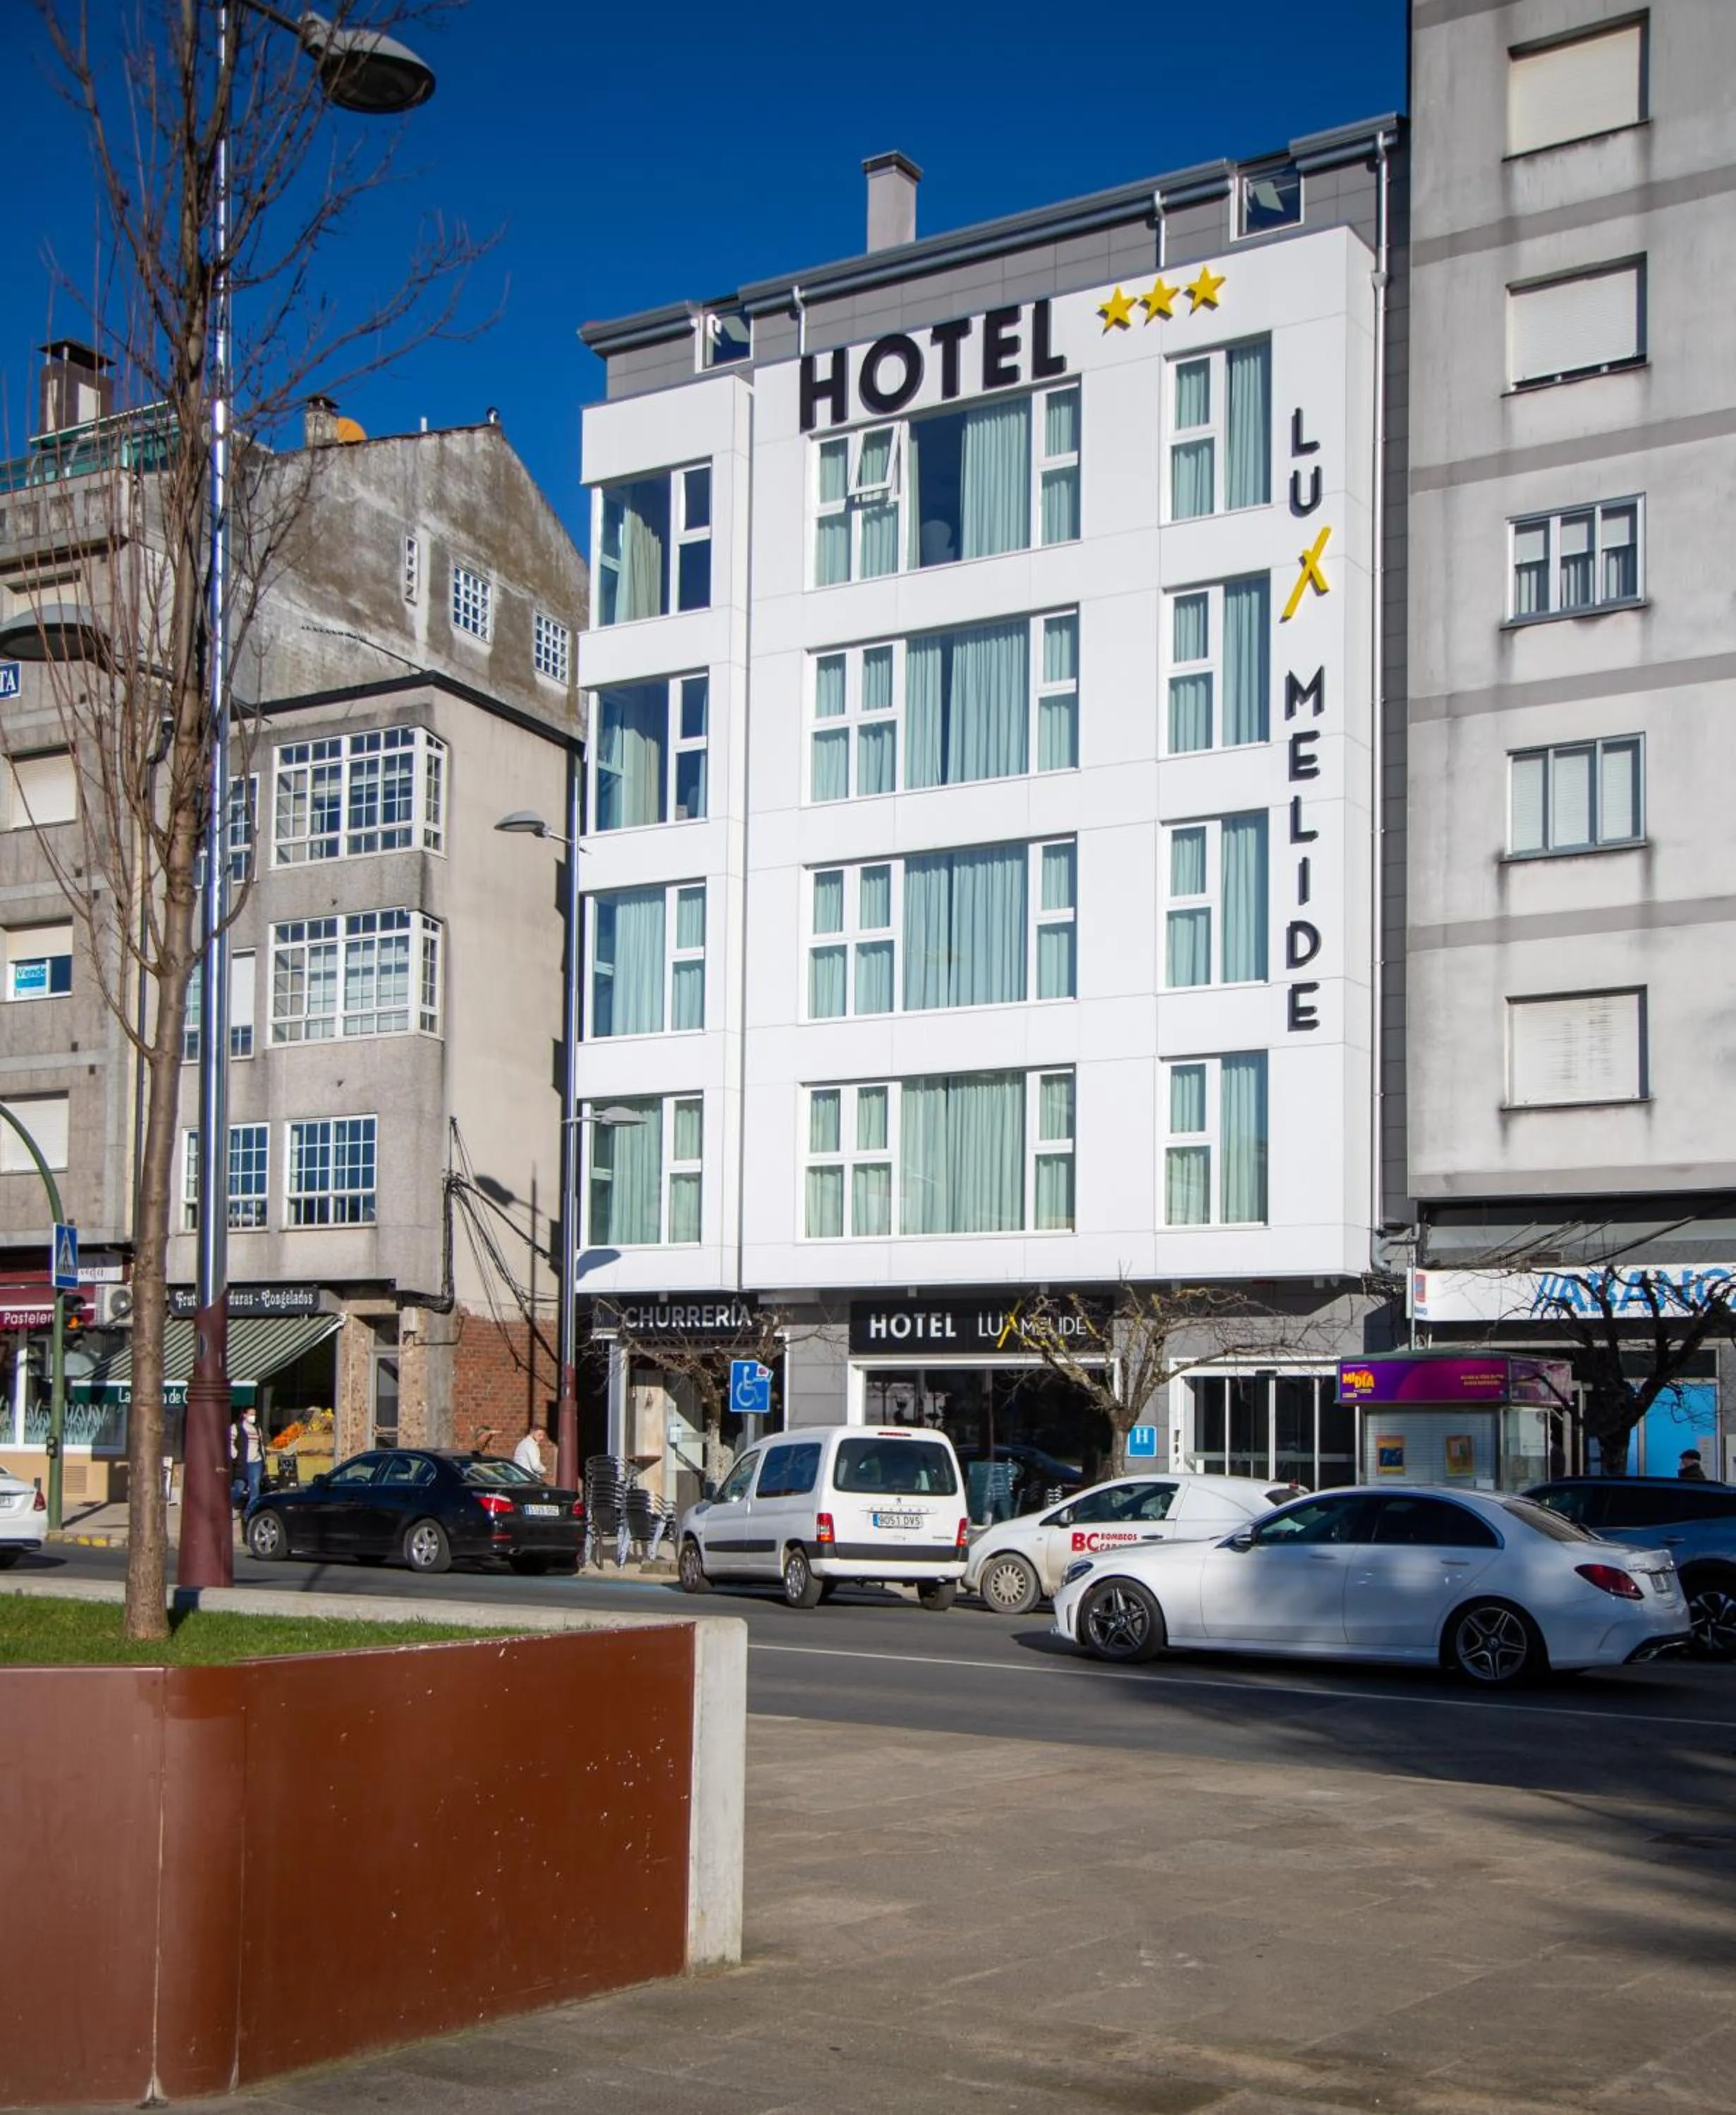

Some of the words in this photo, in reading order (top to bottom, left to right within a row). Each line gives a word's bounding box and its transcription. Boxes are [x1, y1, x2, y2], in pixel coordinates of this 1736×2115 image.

[800, 299, 1066, 433] HOTEL
[1279, 407, 1331, 623] LUX
[1285, 666, 1325, 1031] MELIDE
[176, 1291, 197, 1308] Frut
[228, 1291, 253, 1305] duras
[262, 1289, 313, 1308] Congelados
[1533, 1267, 1736, 1312] ABANC
[4, 1311, 55, 1325] Pasteler
[625, 1299, 752, 1328] CHURRERÍA
[869, 1313, 956, 1338] HOTEL
[1072, 1533, 1099, 1552] BC
